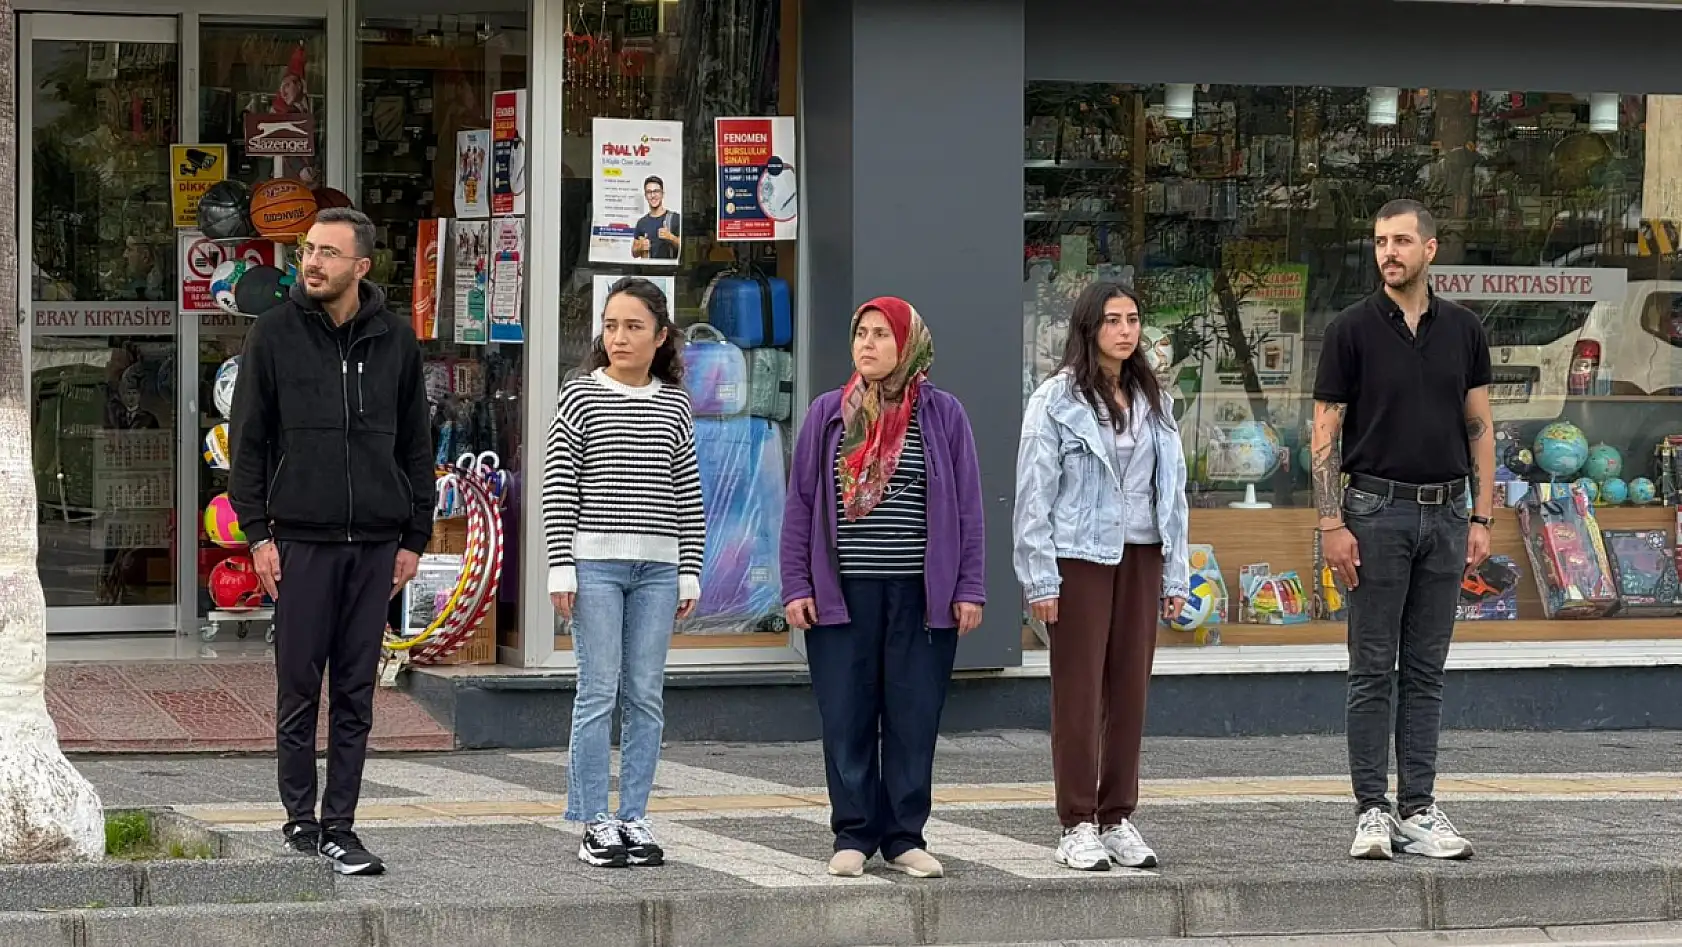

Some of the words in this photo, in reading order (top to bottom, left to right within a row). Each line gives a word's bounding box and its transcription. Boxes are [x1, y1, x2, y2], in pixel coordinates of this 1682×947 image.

[248, 139, 309, 152] Slazenger
[723, 133, 768, 143] FENOMEN
[1482, 271, 1593, 294] KIRTASİYE
[35, 310, 79, 327] ERAY
[84, 306, 172, 327] KIRTASİYE
